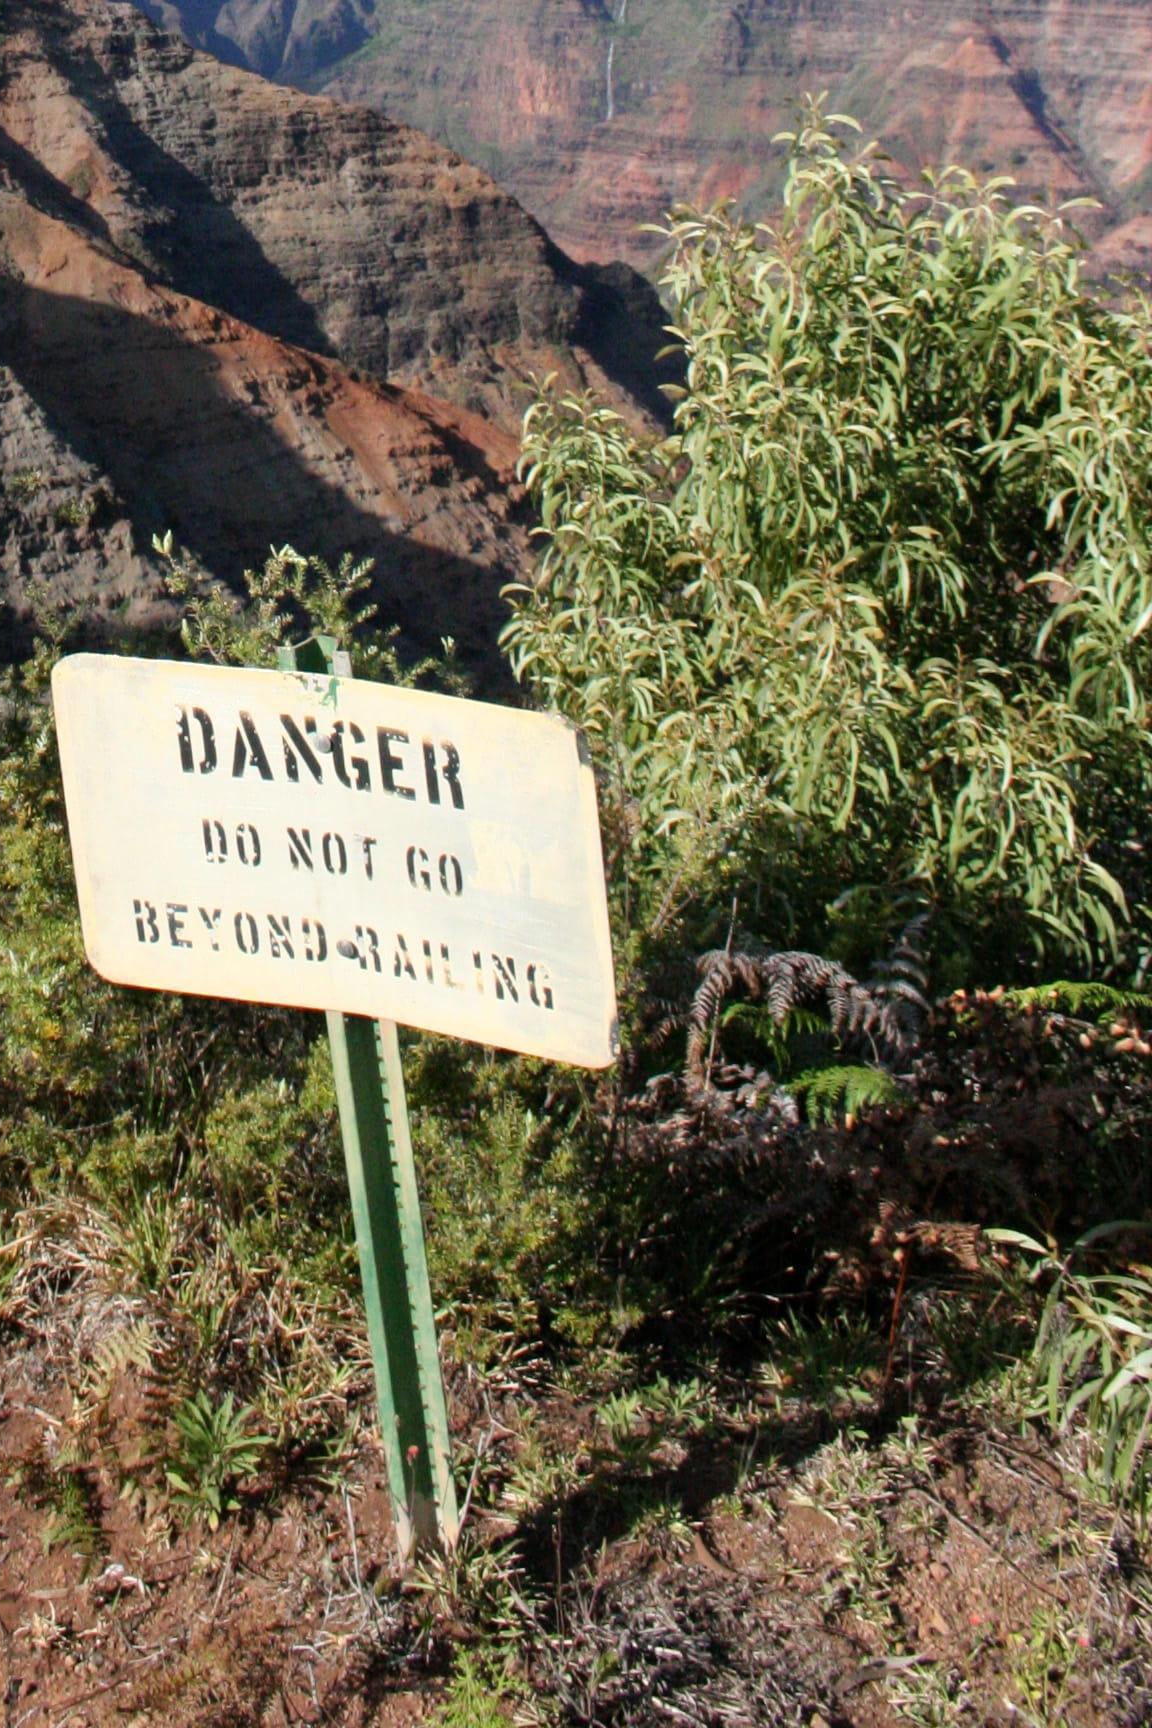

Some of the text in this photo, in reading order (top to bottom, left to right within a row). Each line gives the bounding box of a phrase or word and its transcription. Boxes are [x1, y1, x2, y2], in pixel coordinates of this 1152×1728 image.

[174, 703, 466, 810] DANGER
[201, 818, 464, 897] DO NOT GO
[133, 899, 555, 1010] BEYOND RAILING
